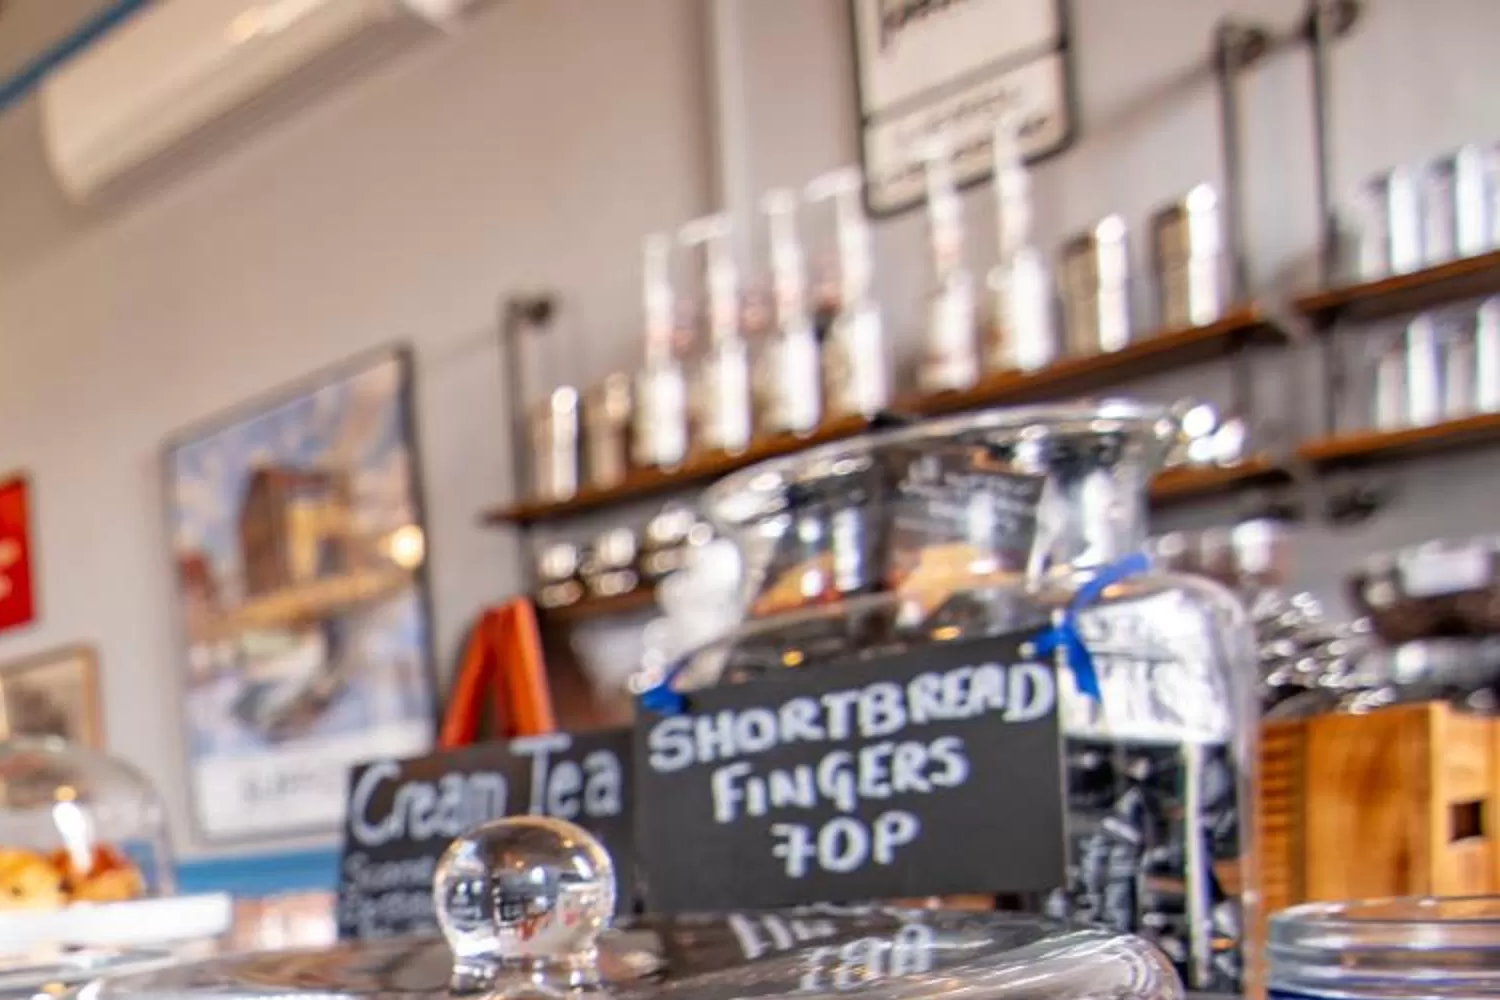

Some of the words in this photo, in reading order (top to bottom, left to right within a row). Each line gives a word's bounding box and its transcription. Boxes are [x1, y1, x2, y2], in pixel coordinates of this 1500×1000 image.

[648, 660, 1058, 773] SHORTBREAD
[351, 759, 508, 847] Cream
[509, 731, 624, 821] Tea
